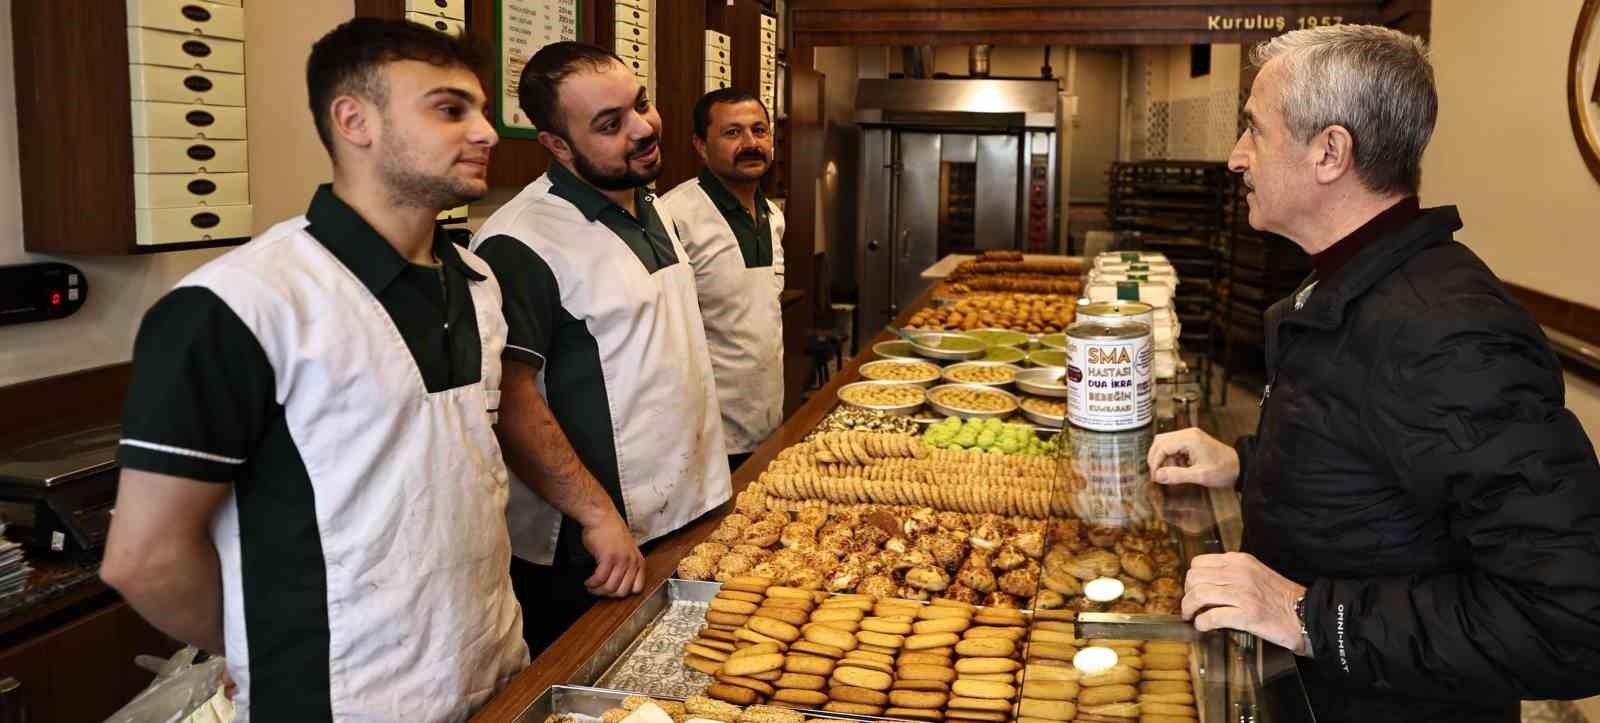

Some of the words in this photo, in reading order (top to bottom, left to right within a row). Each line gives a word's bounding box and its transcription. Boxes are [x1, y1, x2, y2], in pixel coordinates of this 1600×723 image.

[1208, 15, 1285, 31] Kuruluş
[1088, 347, 1131, 364] SMA
[1088, 367, 1131, 377] HASTASI
[1088, 380, 1107, 388] DUA
[1337, 604, 1349, 673] OMNI-HEAT
